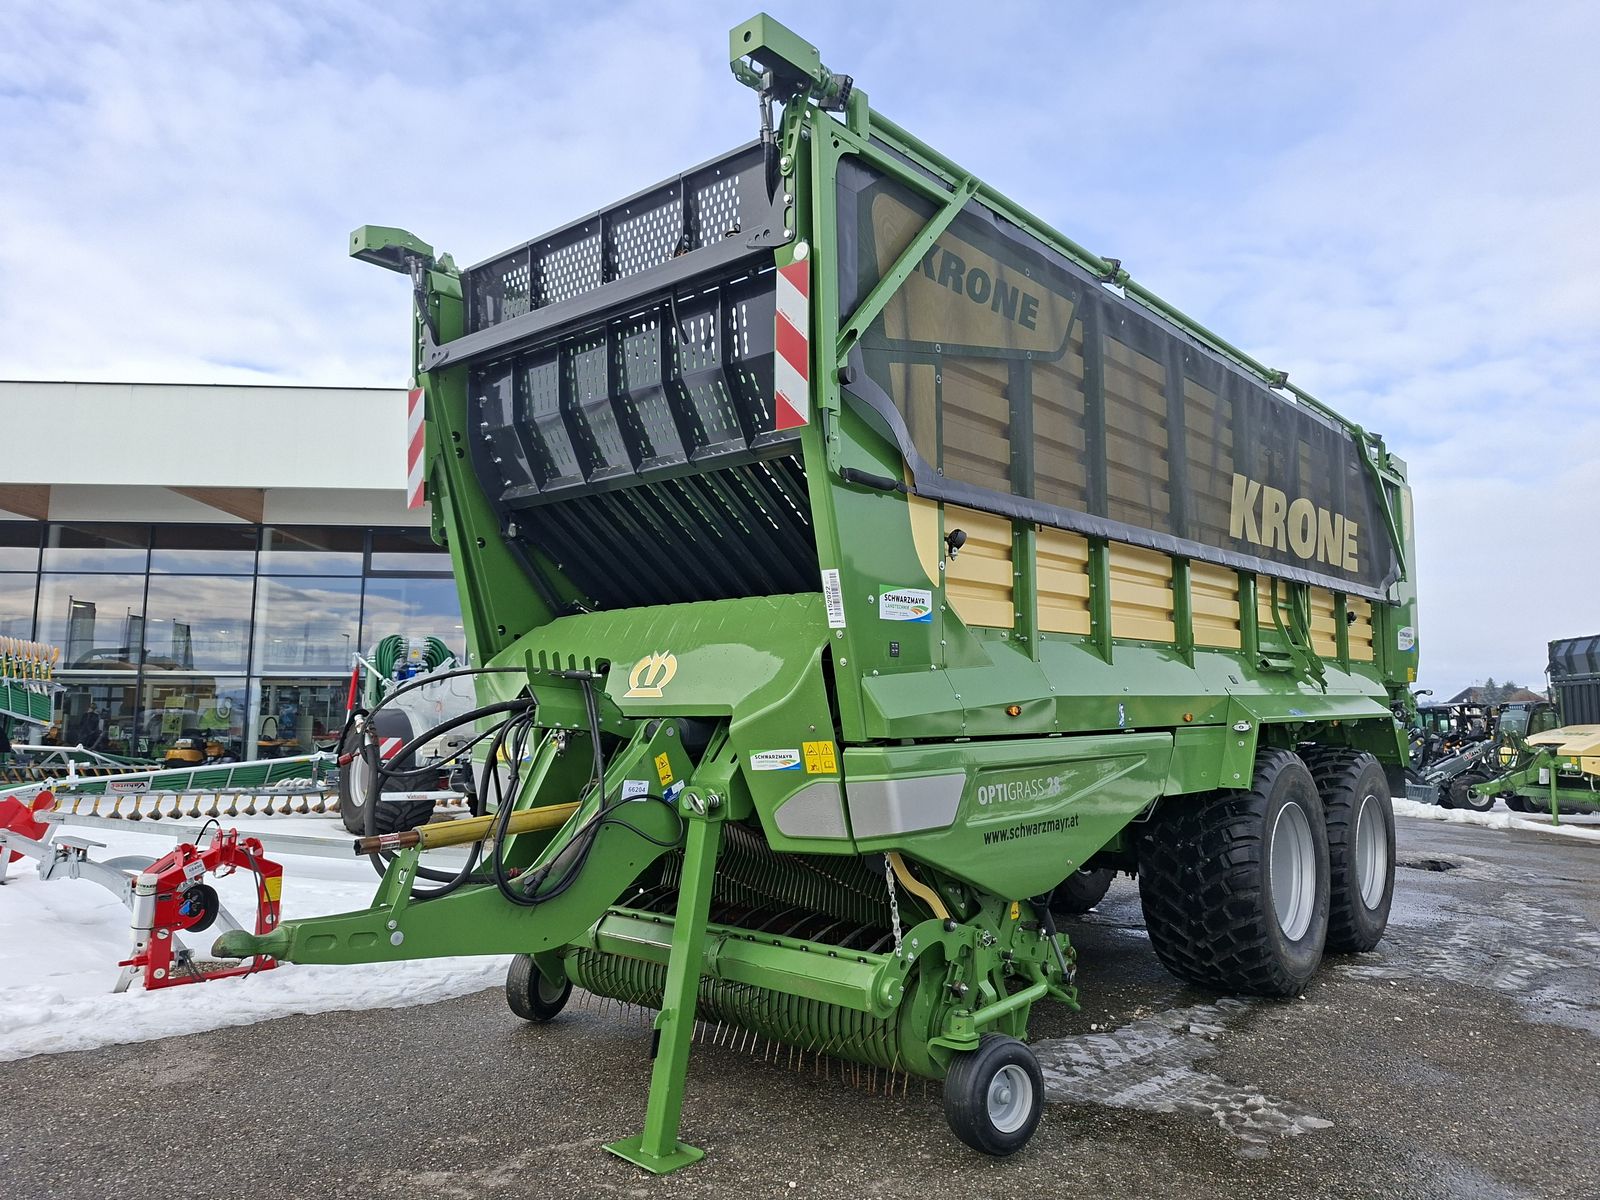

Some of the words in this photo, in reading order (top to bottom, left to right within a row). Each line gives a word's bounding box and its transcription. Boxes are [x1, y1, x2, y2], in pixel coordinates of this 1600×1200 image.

[1229, 472, 1359, 573] KRONE
[825, 586, 834, 616] 1152022
[884, 593, 926, 605] SCHWARZMAYR
[977, 778, 1045, 806] OPTIGRASS
[1046, 776, 1061, 795] 28
[983, 812, 1080, 845] www.schwarzmayr.at
